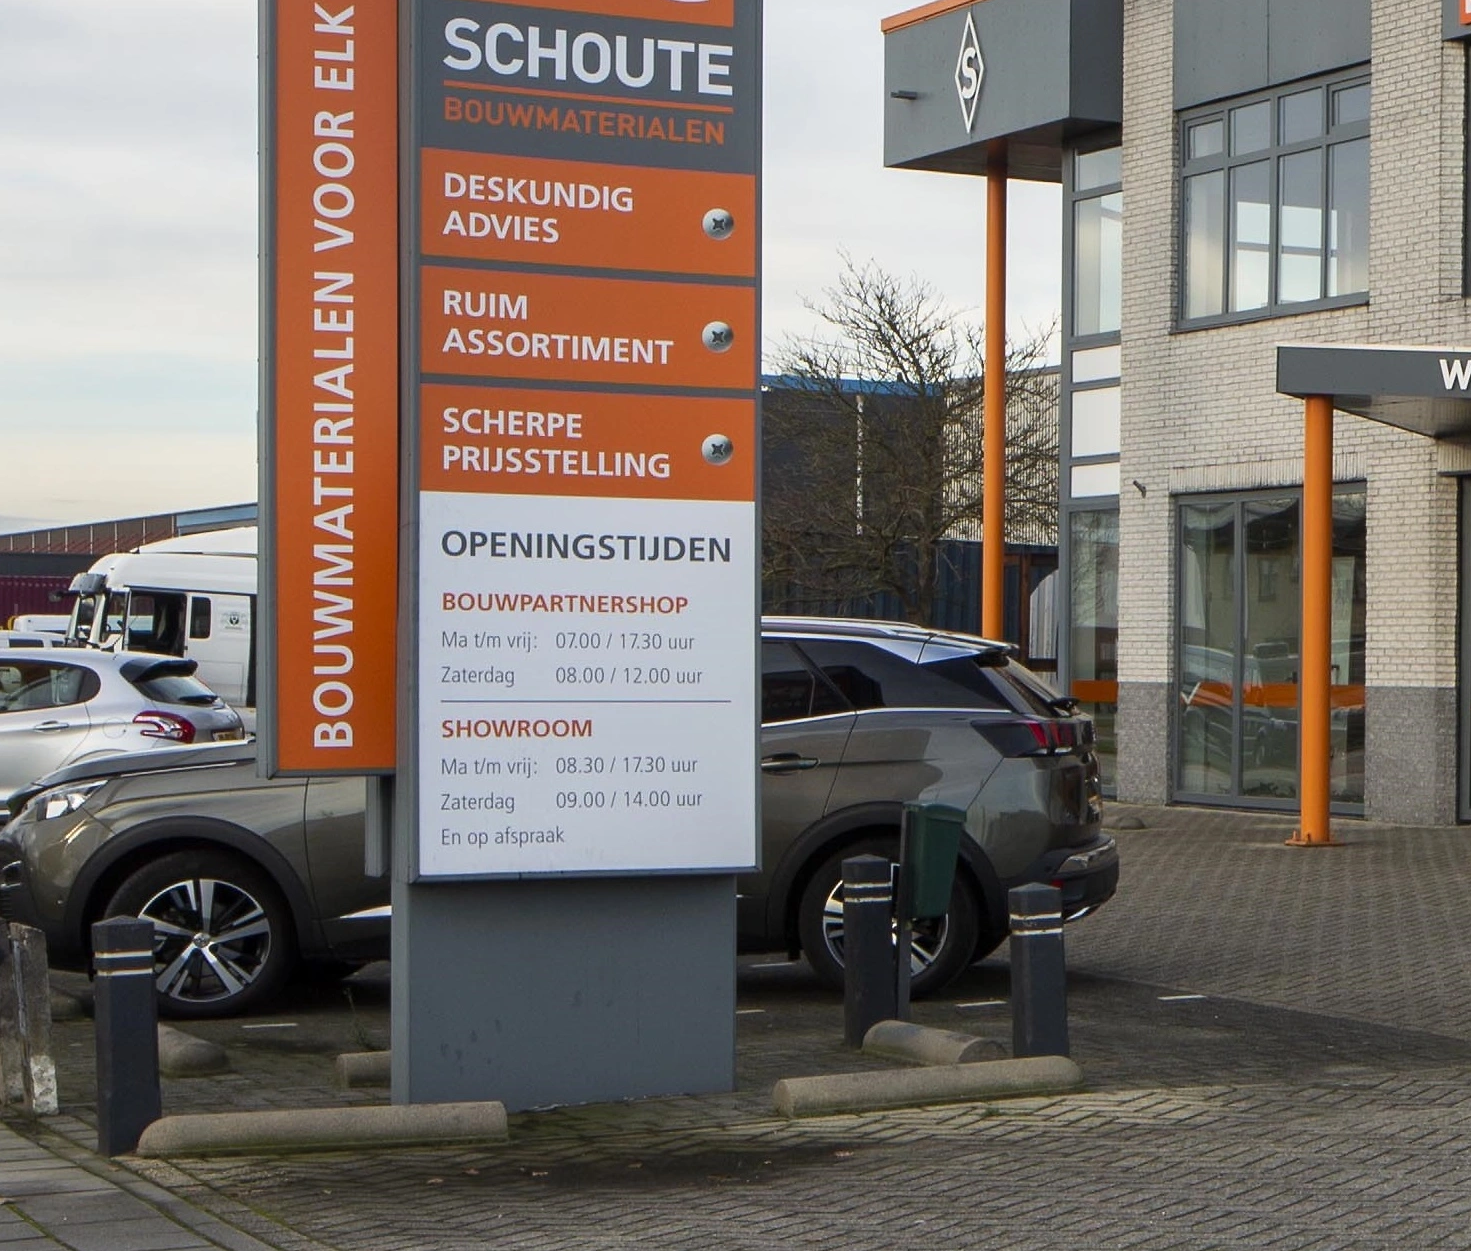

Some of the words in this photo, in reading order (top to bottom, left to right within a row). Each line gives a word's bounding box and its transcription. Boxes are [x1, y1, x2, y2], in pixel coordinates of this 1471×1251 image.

[314, 3, 355, 91] ELK
[443, 17, 734, 96] SCHOUTE
[961, 47, 977, 99] S
[444, 97, 725, 145] BOUWMATERIALEN
[313, 111, 355, 252] VOOR
[444, 172, 634, 212] DESKUNDIG
[443, 211, 559, 243] ADVIES
[443, 290, 528, 320] RUIM
[443, 328, 674, 365] ASSORTIMENT
[443, 407, 582, 439] SCHERPE
[443, 445, 672, 479] PRIJSSTELLING
[313, 272, 354, 748] BOUWMATERIALEN
[441, 530, 731, 562] OPENINGSTIJDEN
[441, 593, 688, 614] BOUWPARTNERSHOP
[441, 631, 468, 648] Ma
[474, 631, 501, 649] t/m
[507, 631, 538, 653] vrij:
[556, 632, 601, 649] 07.00
[606, 633, 612, 649] /
[620, 633, 662, 649] 17.30
[668, 638, 695, 650] uur
[441, 666, 515, 687] Zaterdag
[556, 667, 605, 683] 08.00
[609, 667, 617, 684] /
[625, 668, 670, 683] 12.00
[676, 672, 702, 684] uur
[441, 720, 593, 738] SHOWROOM
[441, 758, 468, 775] Ma
[474, 758, 501, 775] t/m
[507, 757, 538, 778] vrij:
[556, 757, 604, 774] 08.30
[609, 757, 617, 773] /
[624, 756, 666, 773] 17.30
[671, 760, 698, 773] uur
[441, 793, 515, 814] Zaterdag
[556, 791, 605, 809] 09.00
[610, 792, 617, 808] /
[625, 791, 671, 808] 14.00
[676, 794, 702, 807] uur
[441, 829, 461, 845] En
[467, 832, 489, 849] op
[494, 827, 565, 847] afspraak
